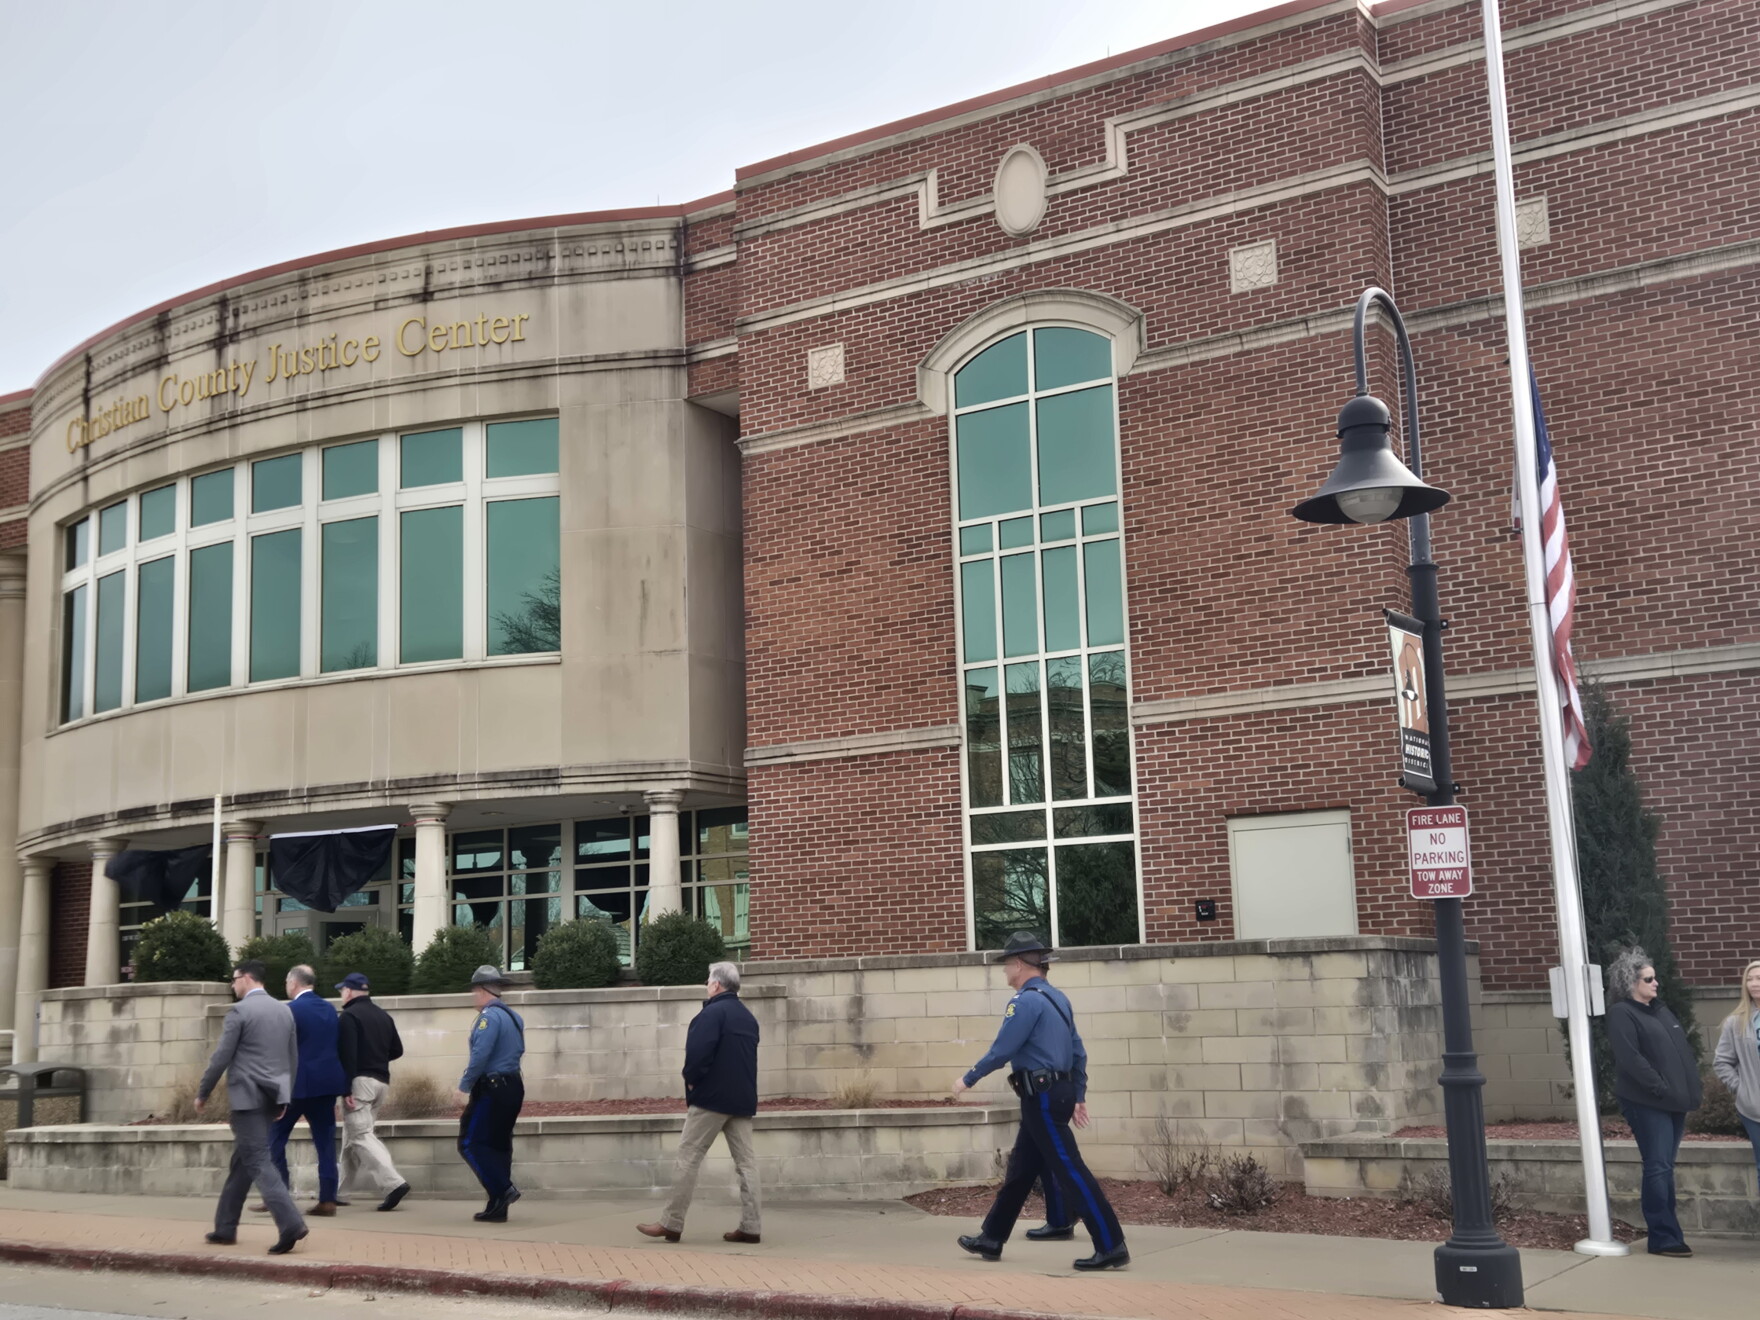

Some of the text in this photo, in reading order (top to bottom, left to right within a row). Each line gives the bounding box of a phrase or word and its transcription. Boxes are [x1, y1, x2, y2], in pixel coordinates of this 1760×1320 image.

[67, 312, 529, 454] Christian County Justice Center
[1405, 743, 1429, 760] HISTORIC
[1412, 813, 1461, 826] FIRE LANE
[1430, 832, 1446, 846] NO
[1414, 850, 1465, 865] PARKING
[1417, 870, 1463, 882] TOW AWAY
[1428, 882, 1454, 894] ZONE
